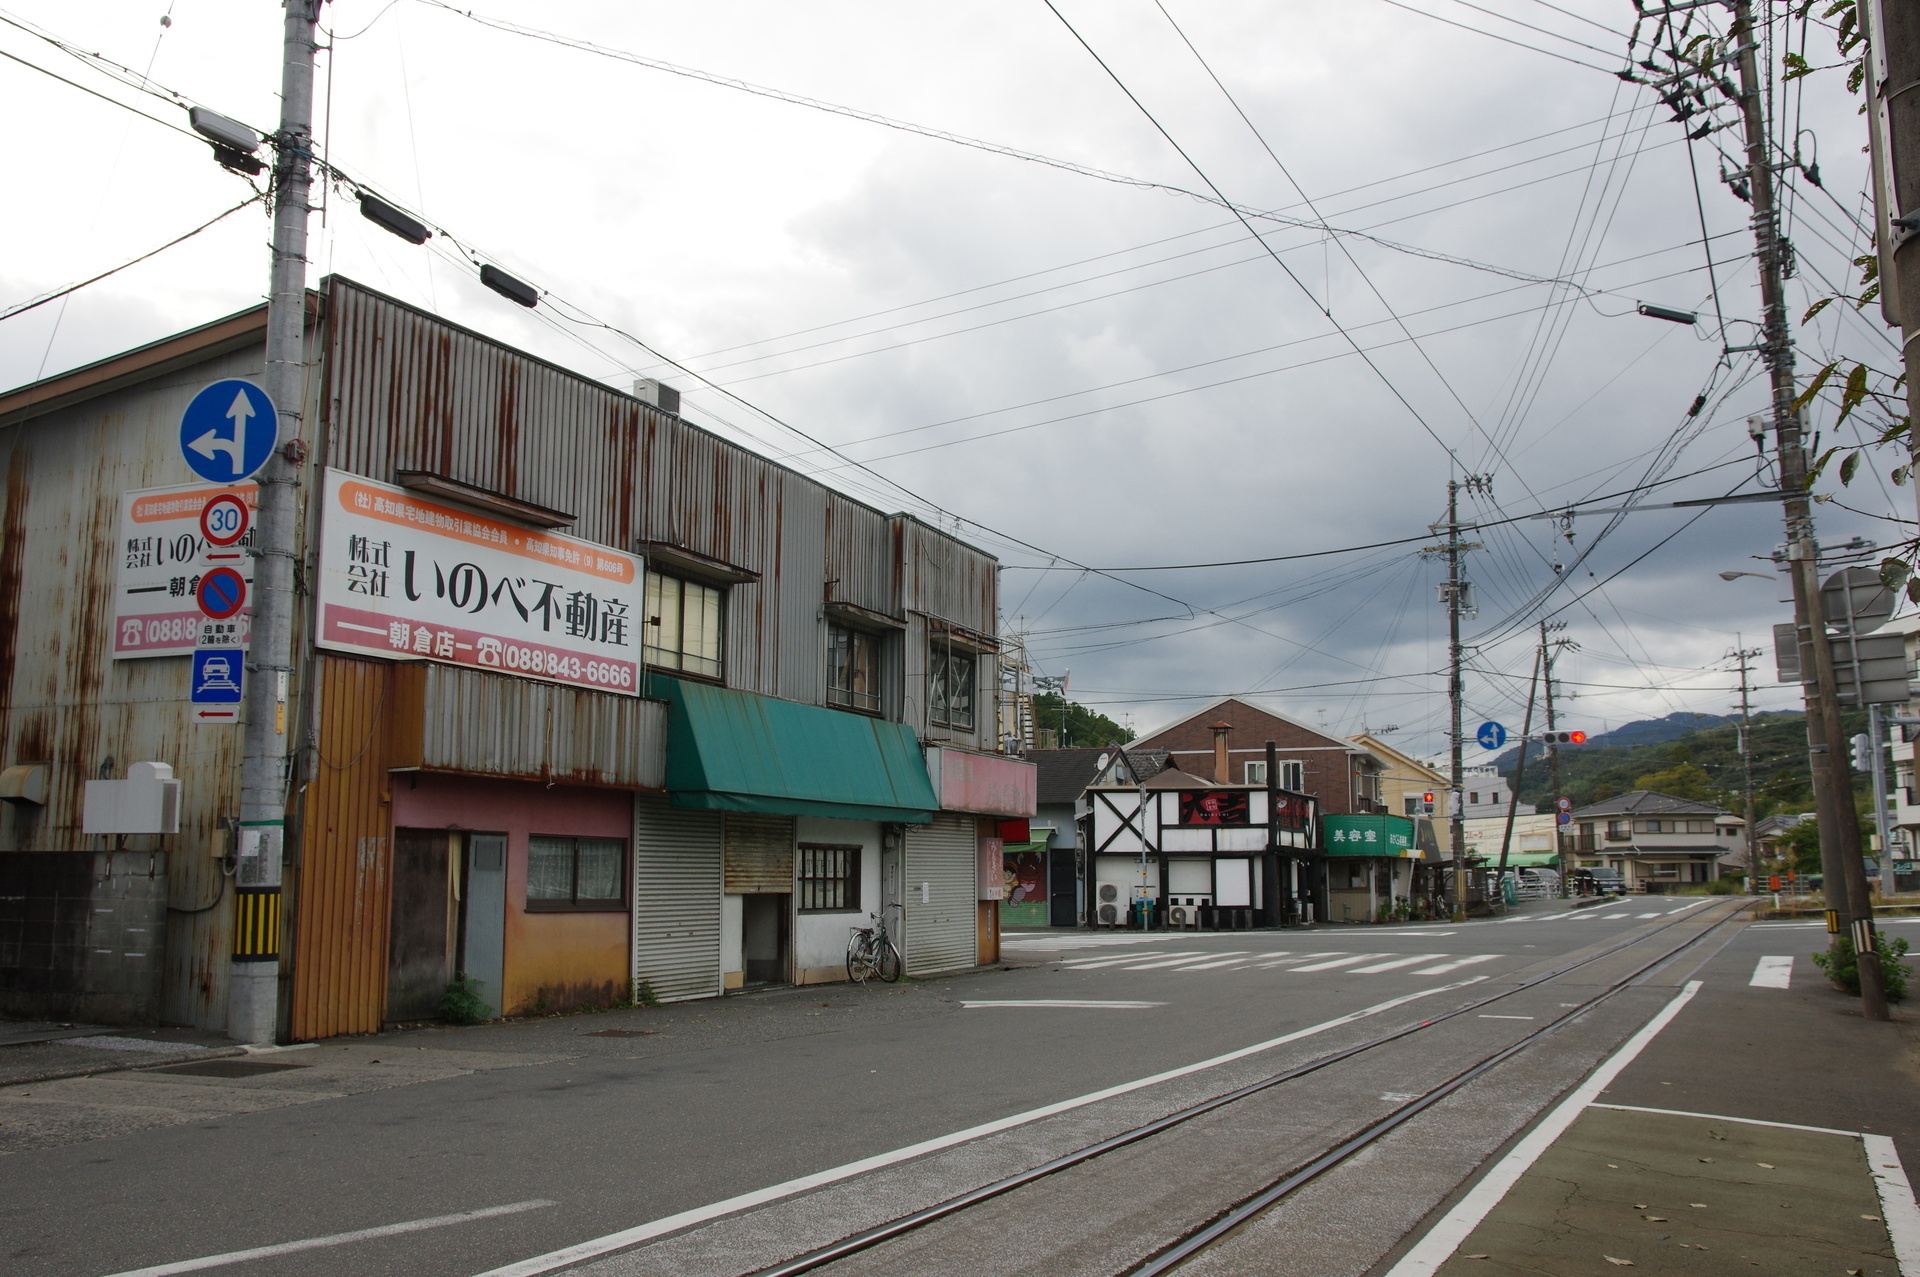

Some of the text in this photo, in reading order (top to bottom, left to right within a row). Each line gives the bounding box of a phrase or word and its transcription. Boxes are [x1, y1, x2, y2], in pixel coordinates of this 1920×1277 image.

[211, 508, 238, 531] 30
[404, 550, 629, 647] いのべ不動産
[204, 624, 236, 634] 自動車
[501, 642, 631, 687] (088)843-6666
[1333, 829, 1377, 842] 美容室
